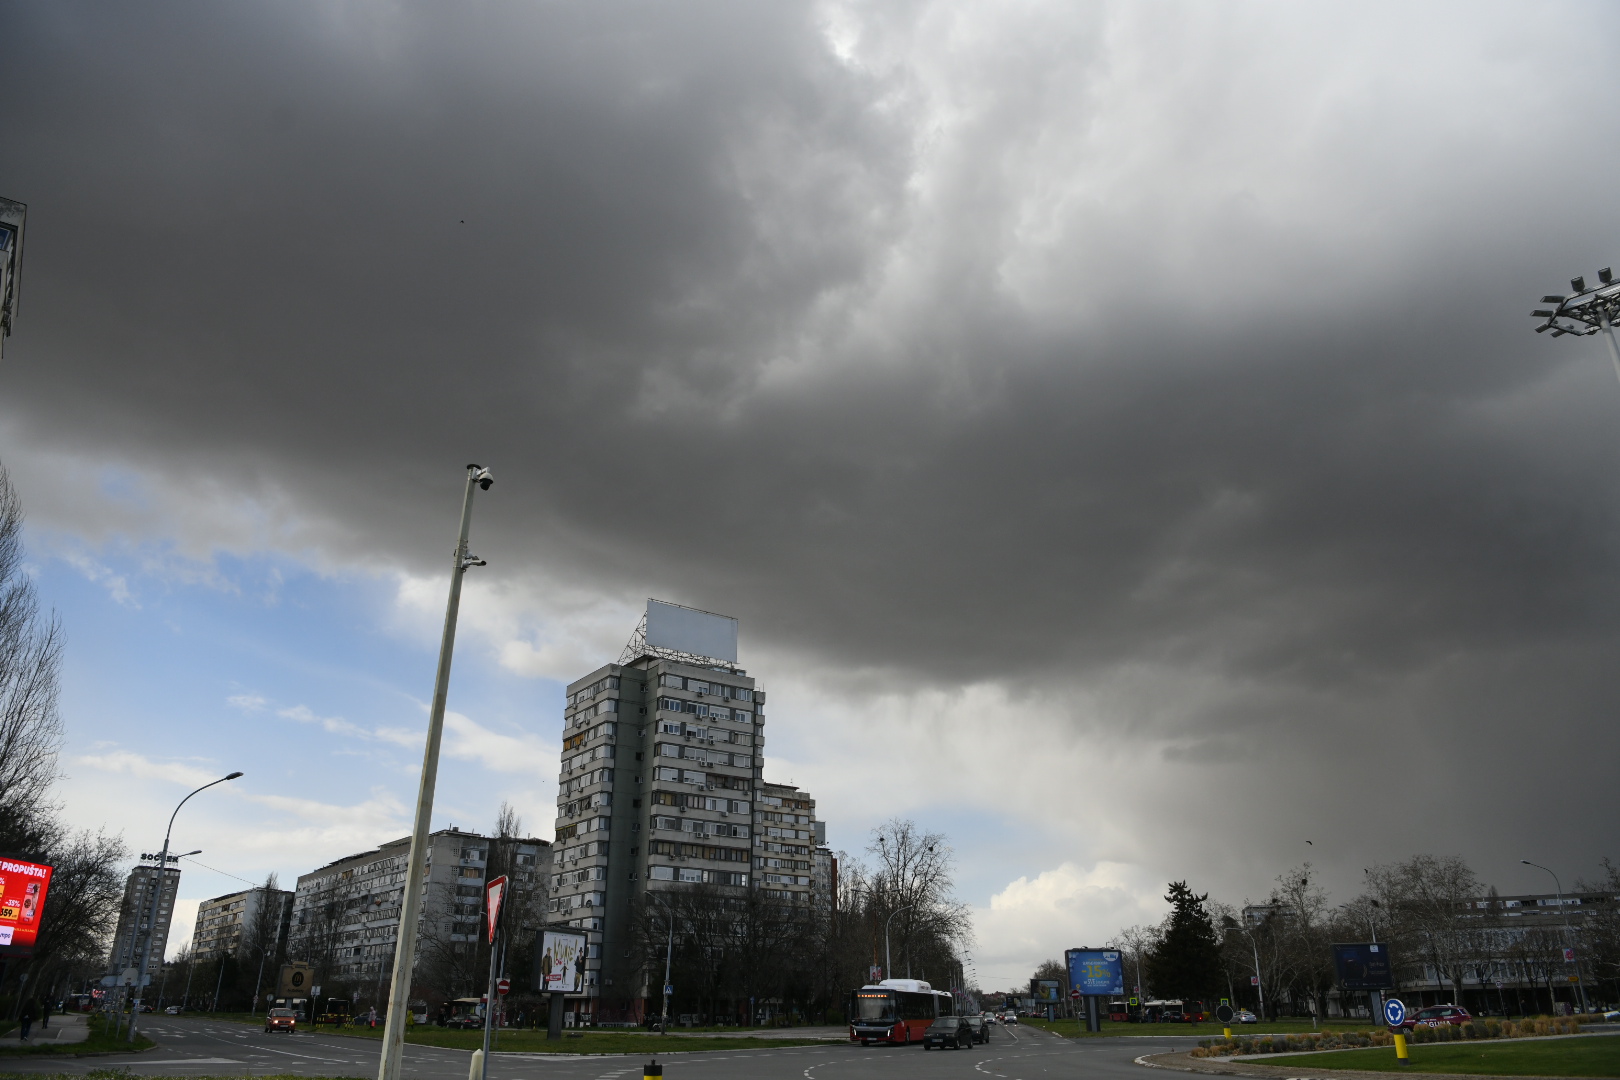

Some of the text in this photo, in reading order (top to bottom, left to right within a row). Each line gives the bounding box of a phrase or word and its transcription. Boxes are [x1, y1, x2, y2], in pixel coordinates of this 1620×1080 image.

[141, 853, 178, 863] SOCER
[2, 861, 46, 878] PROPUŠTA!
[1081, 965, 1111, 978] -15%
